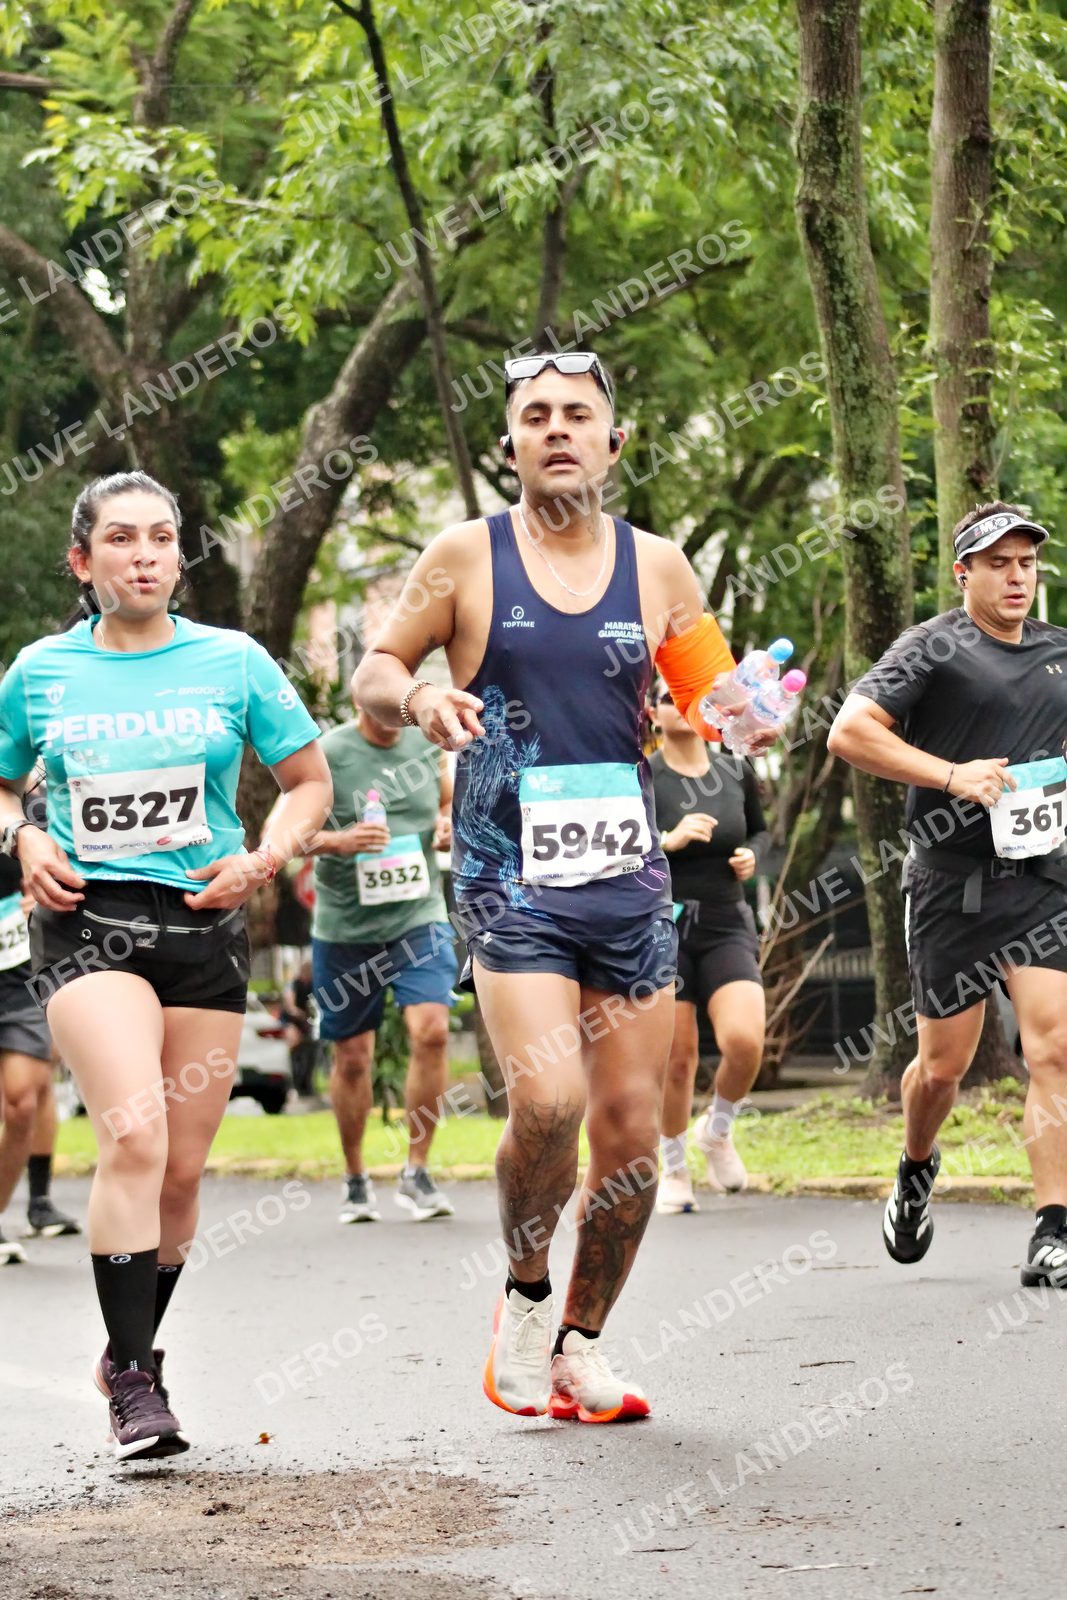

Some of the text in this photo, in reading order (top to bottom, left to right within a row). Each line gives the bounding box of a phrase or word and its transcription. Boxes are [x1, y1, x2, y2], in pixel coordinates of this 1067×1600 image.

[178, 685, 225, 697] BROOKS
[45, 707, 228, 748] PERDURA
[81, 786, 199, 832] 6327
[532, 818, 643, 861] 5942
[363, 865, 422, 889] 3932
[622, 864, 640, 873] 5942
